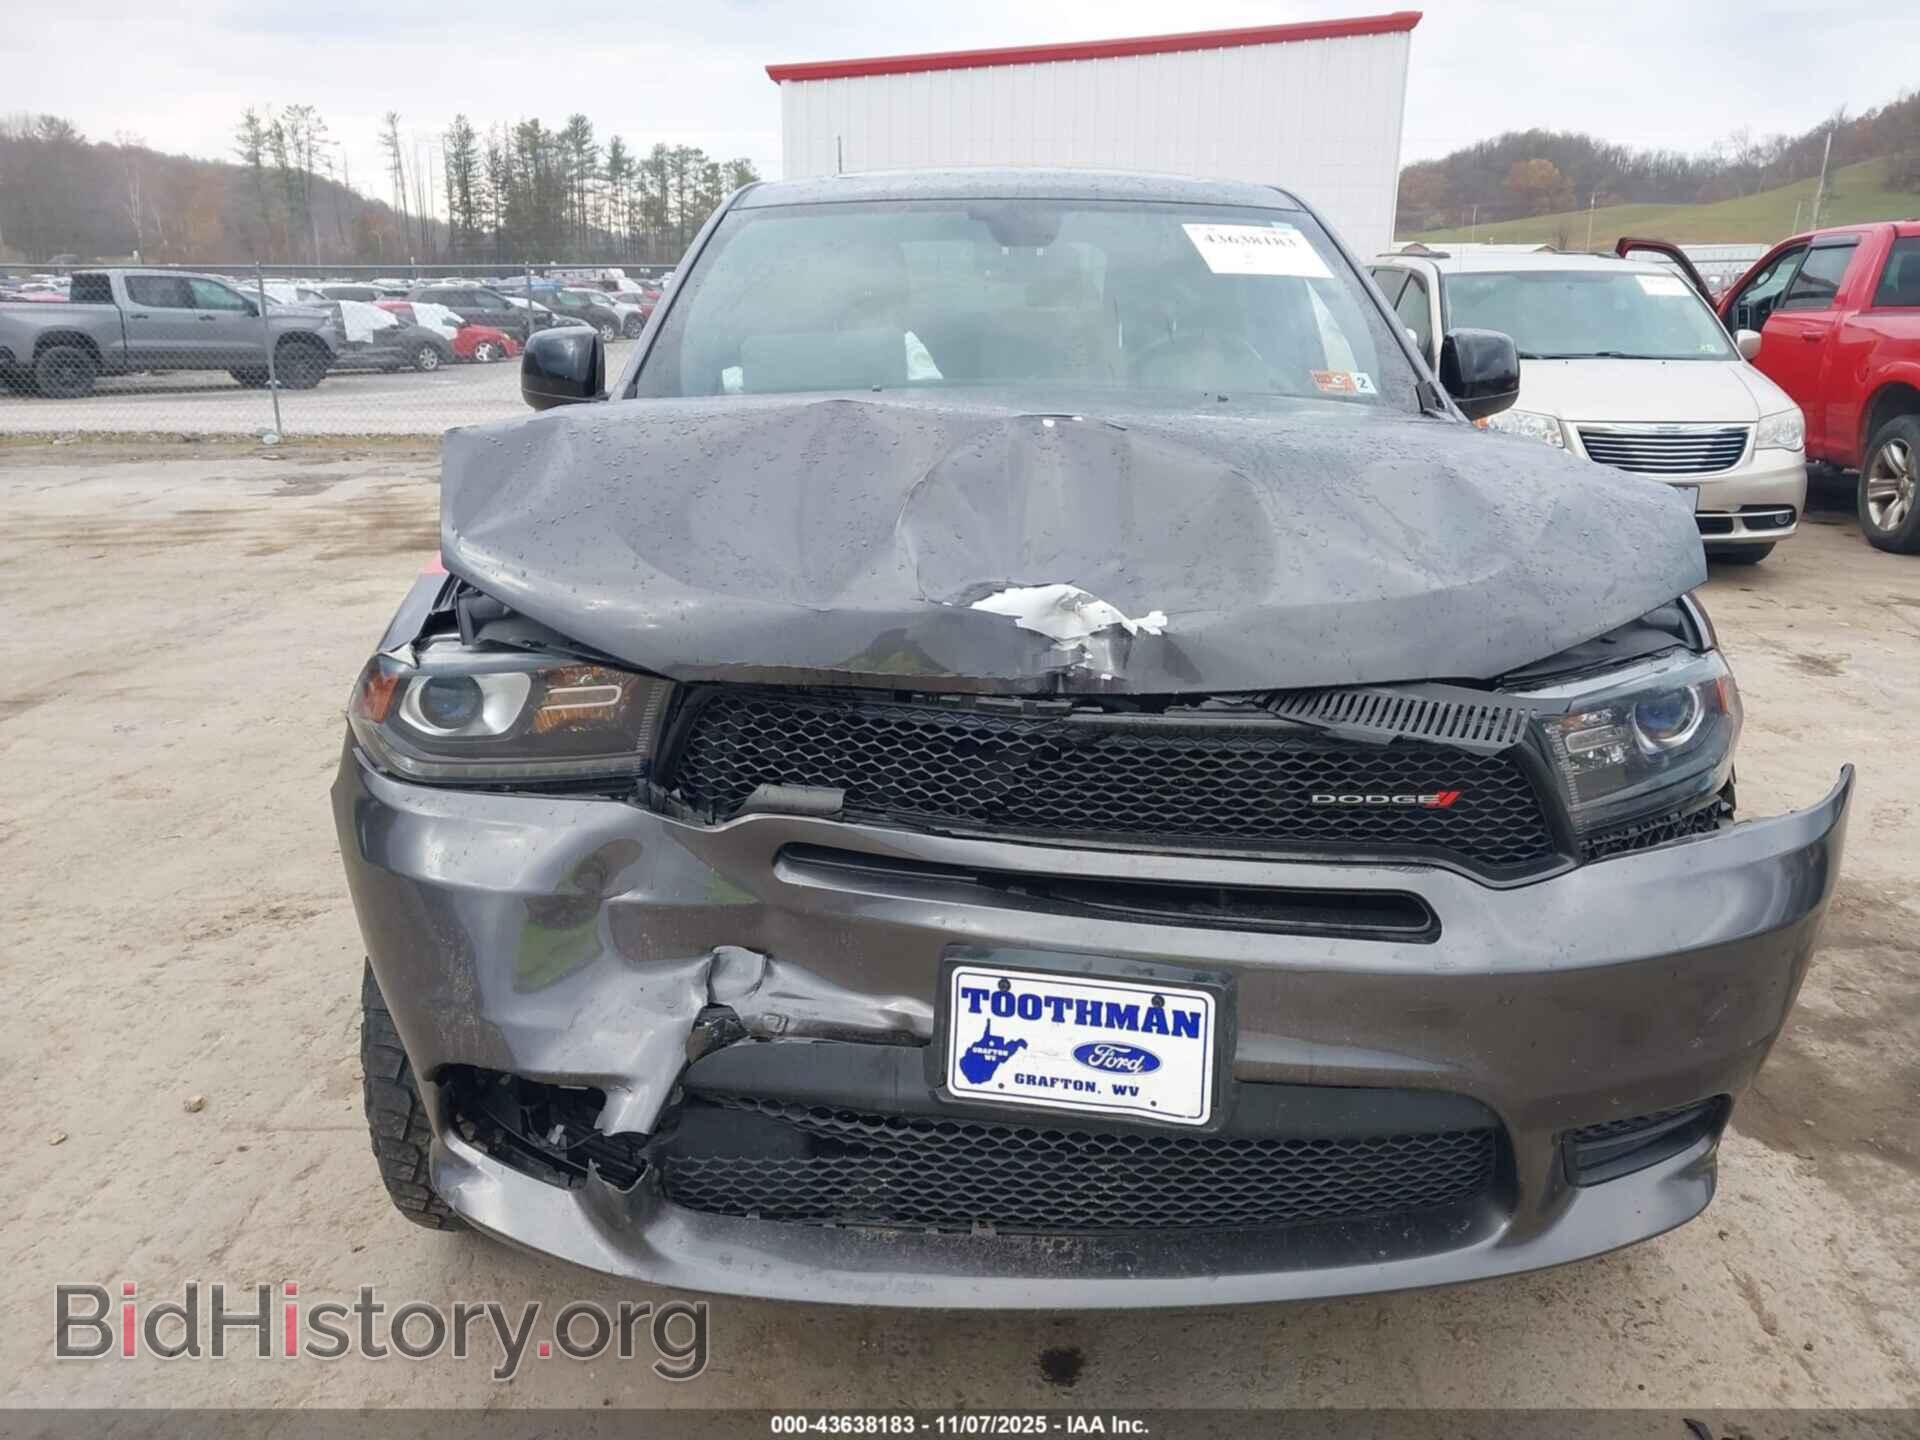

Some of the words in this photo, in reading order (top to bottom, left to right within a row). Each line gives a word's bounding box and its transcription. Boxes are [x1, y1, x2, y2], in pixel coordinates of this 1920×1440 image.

[1312, 794, 1441, 804] DODGE
[961, 987, 1201, 1039] TOOTHMAN
[1088, 1045, 1144, 1073] Ford
[1112, 1084, 1139, 1096] WV
